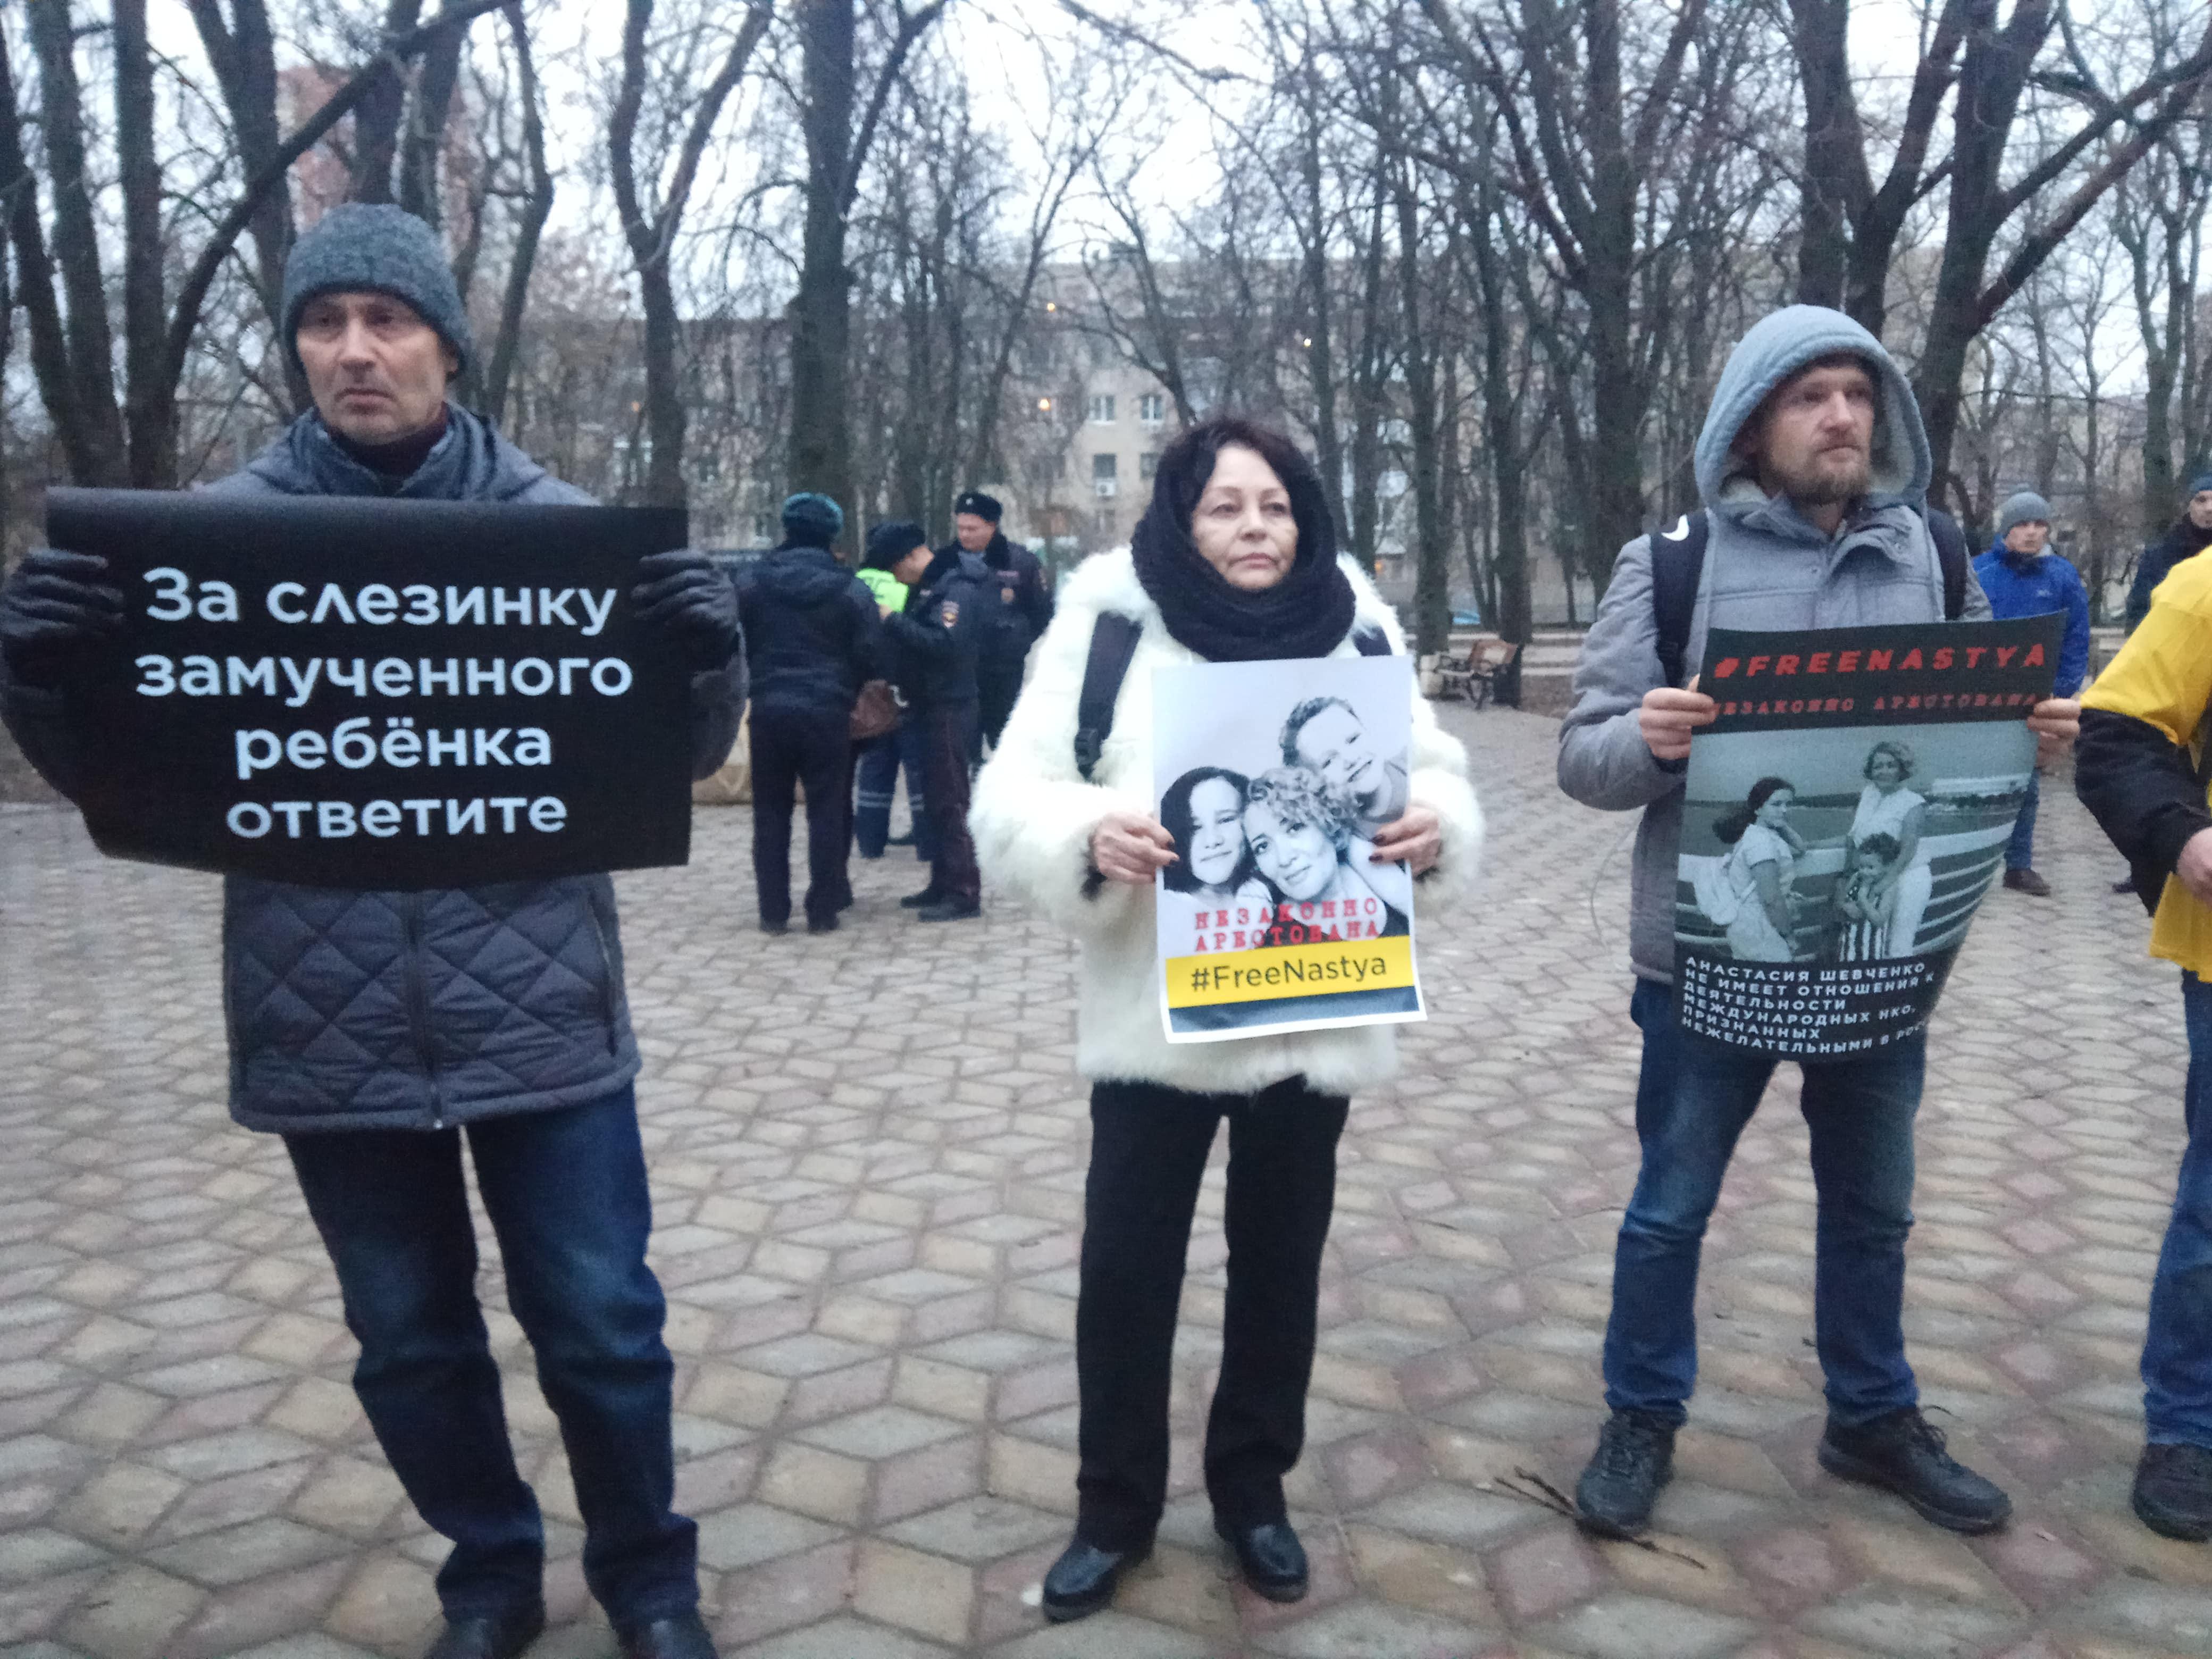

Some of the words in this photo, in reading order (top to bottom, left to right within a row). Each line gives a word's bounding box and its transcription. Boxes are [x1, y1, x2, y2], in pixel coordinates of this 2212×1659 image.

[144, 567, 238, 621] За
[266, 582, 616, 636] слезинку
[1714, 643, 2044, 678] #FREENASTYA
[135, 655, 633, 707] замученного
[236, 716, 551, 780] ребёнка
[227, 796, 567, 838] ответите
[1195, 898, 1377, 929] НЕЗАКОННО
[1195, 920, 1379, 952] АРЕСТОВАНА
[1191, 956, 1387, 992] #FreeNastya
[1686, 969, 1708, 984] НЕ
[1719, 978, 1787, 995] ИМЕЕТ
[1798, 976, 1918, 996] ОТНОШЕНИЯ
[1925, 971, 1934, 983] К
[1687, 957, 1810, 982] АНАСТАСИЯ
[1820, 962, 1925, 982] ШЕВЧЕНКО
[1683, 981, 1847, 1011] ДЕЯТЕЛЬНОСТИ
[1683, 993, 1870, 1027] МЕЖДУНАРОДНЫХ
[1681, 1017, 1873, 1054] НЕЖЕЛАТЕЛЬНЫМИ
[1683, 1005, 1820, 1040] ПРИЗНАННЫХ
